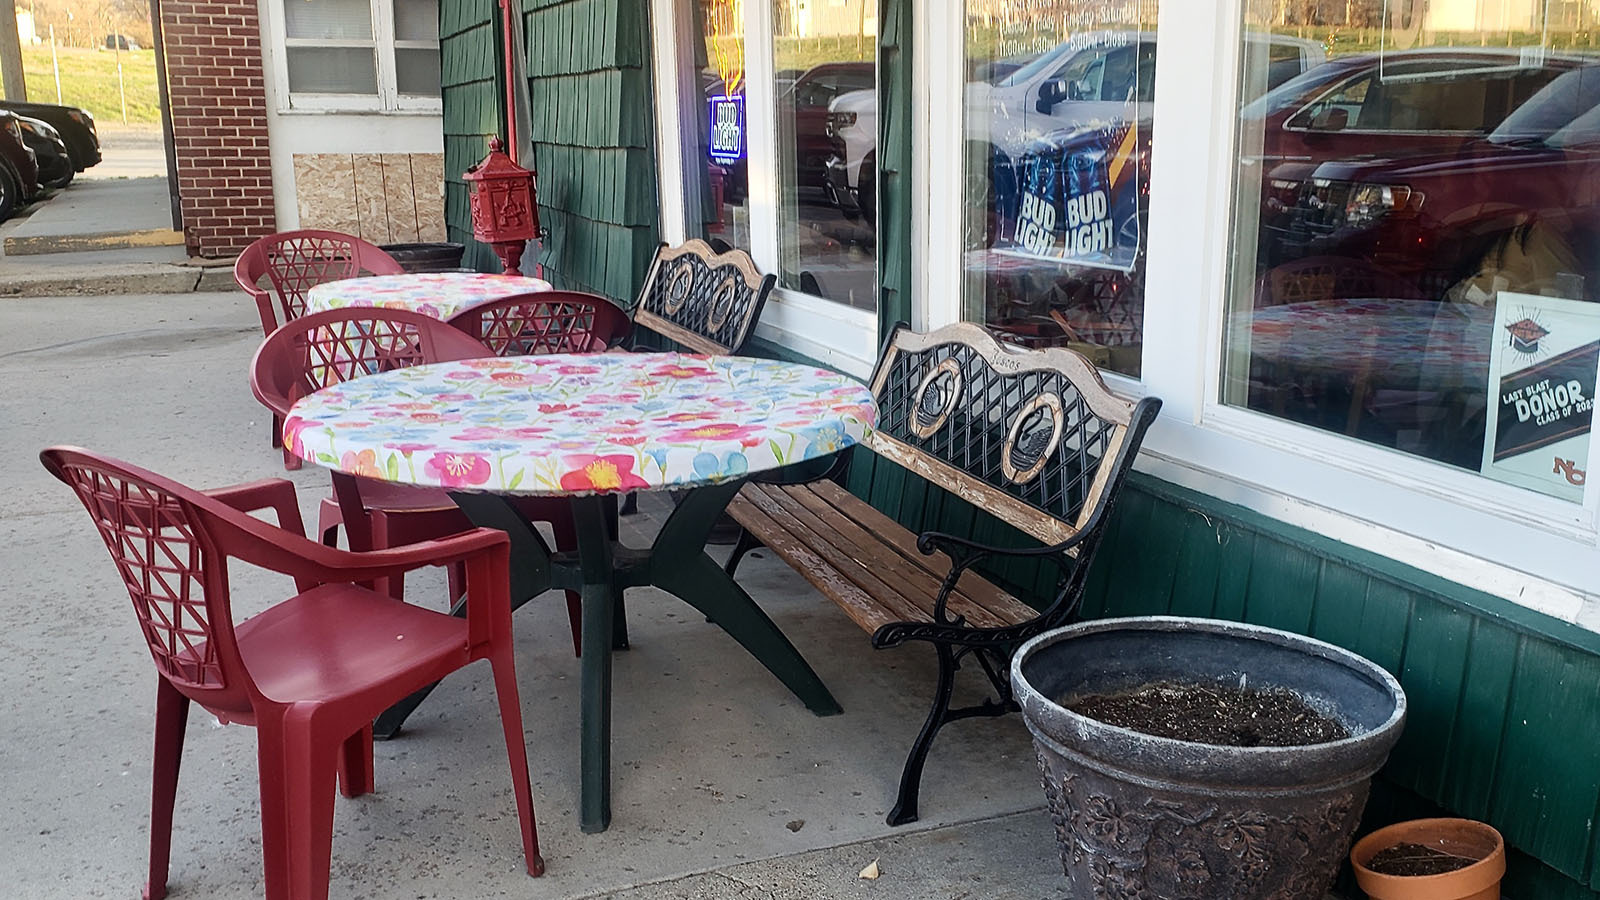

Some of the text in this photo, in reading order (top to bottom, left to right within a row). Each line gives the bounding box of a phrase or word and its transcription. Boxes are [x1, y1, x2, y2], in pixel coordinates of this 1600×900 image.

[1104, 30, 1127, 48] Close
[717, 102, 737, 125] BUD
[713, 125, 740, 151] LIGHT
[1021, 191, 1056, 231] BUD
[1067, 190, 1108, 229] BUD
[1014, 216, 1057, 257] LIGHT
[1063, 218, 1114, 259] LIGHT
[1502, 379, 1550, 405] LAST BLAST
[1515, 379, 1585, 423] DONOR
[1536, 410, 1560, 426] CLASS
[1562, 405, 1572, 418] OF
